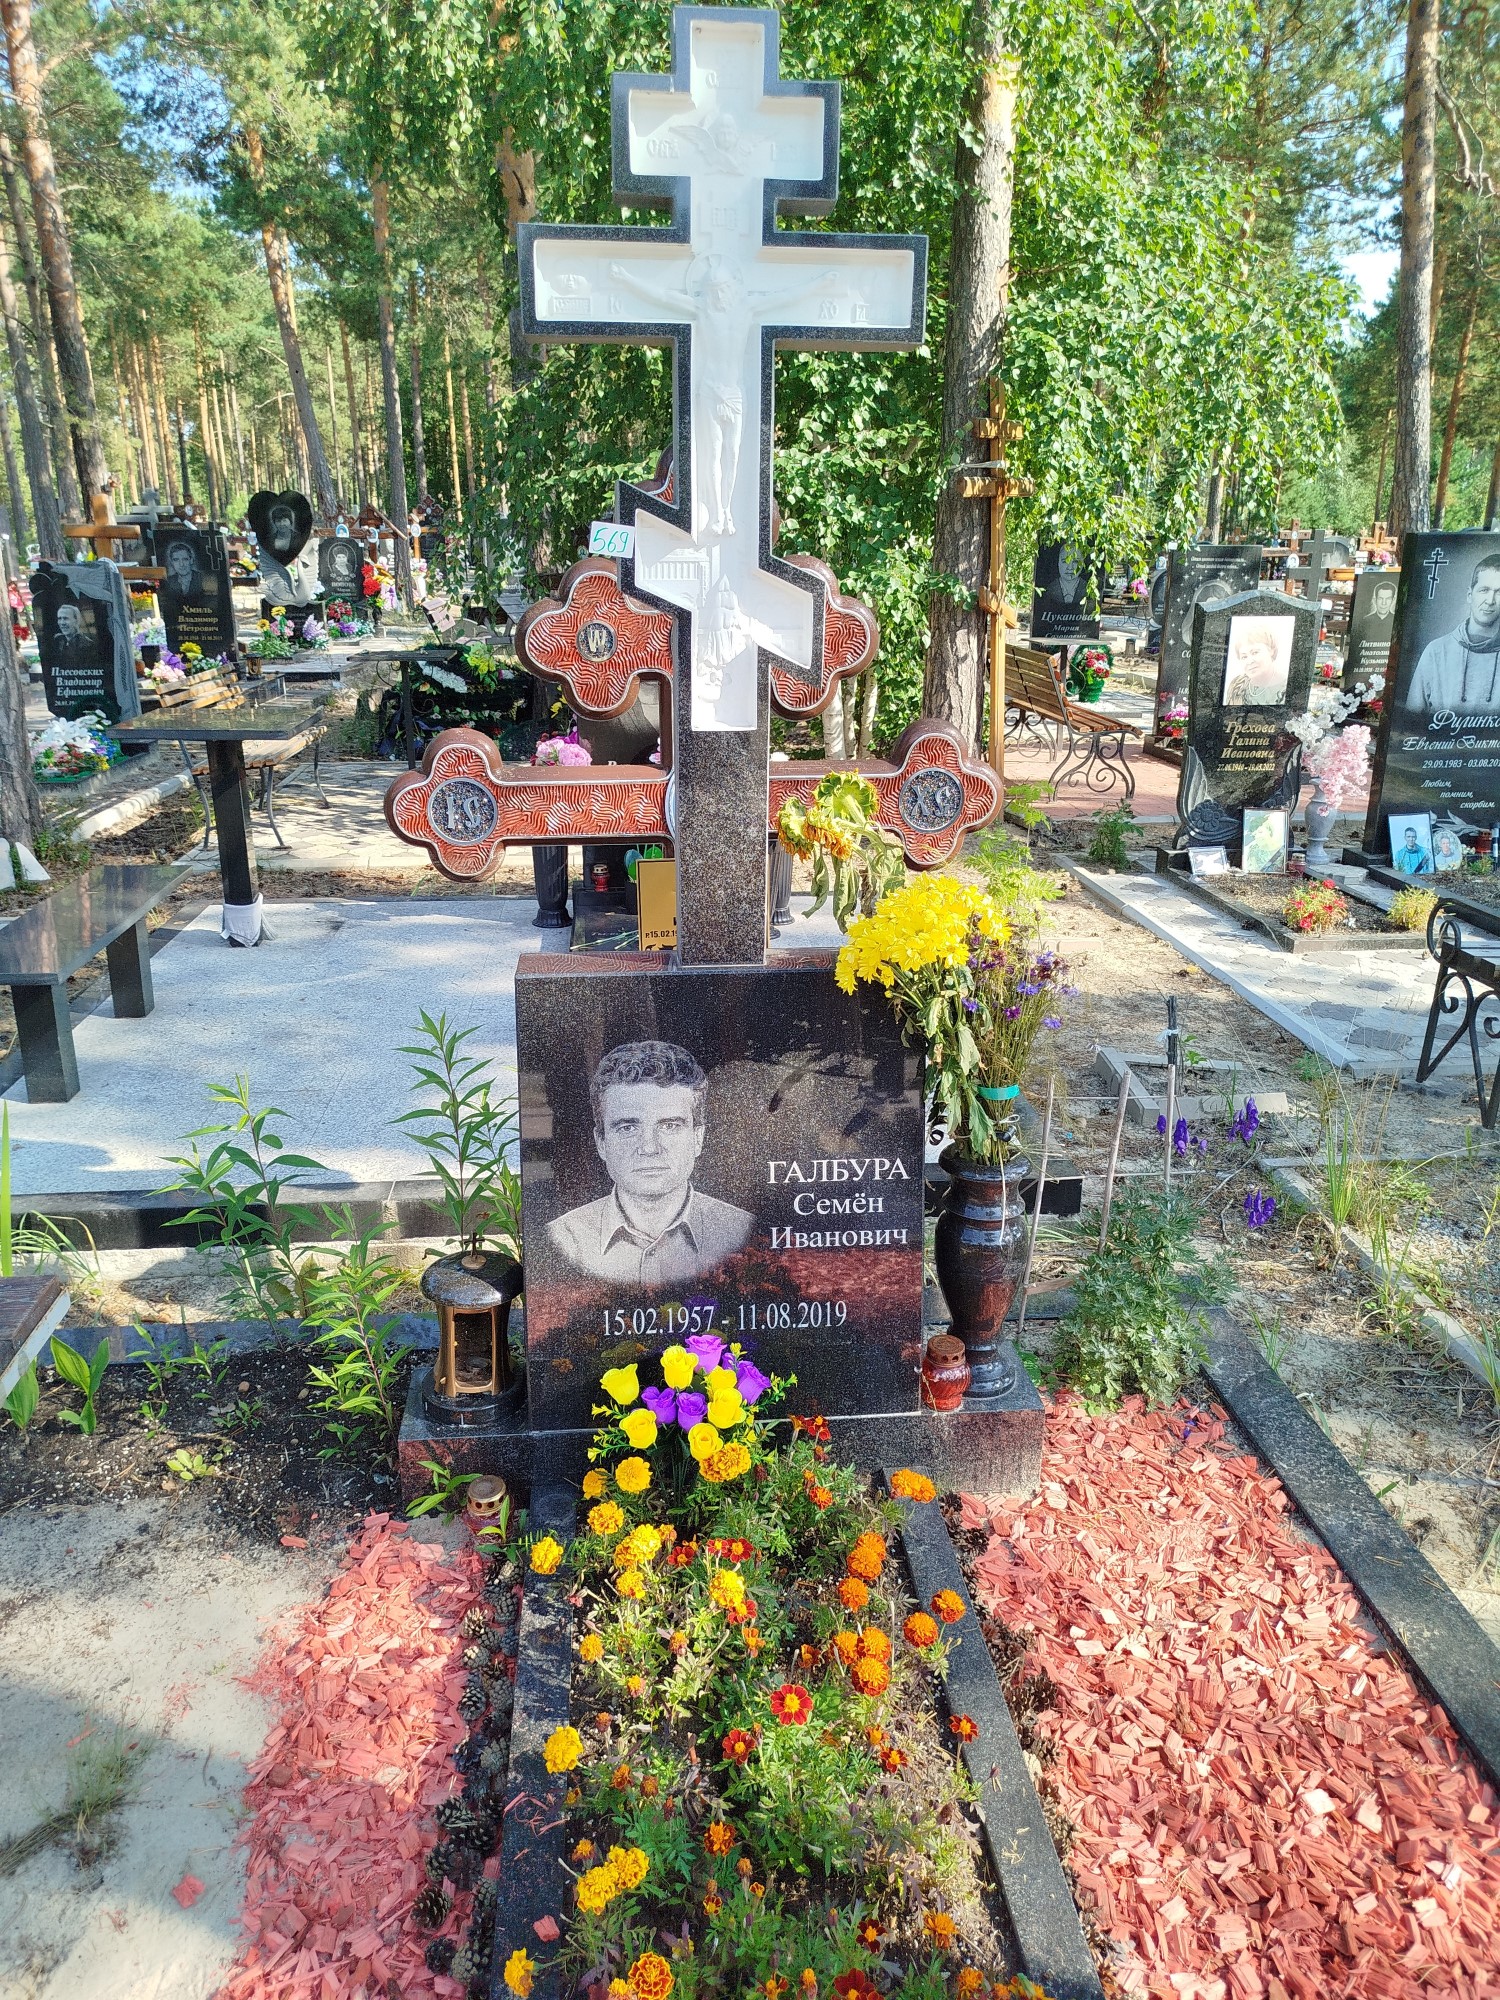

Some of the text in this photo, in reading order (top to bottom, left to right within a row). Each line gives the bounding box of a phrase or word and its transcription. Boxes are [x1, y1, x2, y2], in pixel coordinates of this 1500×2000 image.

[592, 527, 630, 553] 569
[183, 605, 213, 614] Хмиль
[178, 615, 219, 624] Владимир
[1041, 611, 1094, 623] Цуканова
[179, 624, 219, 633] Петрович
[1053, 624, 1080, 633] Мария
[51, 667, 105, 677] Плесовских
[56, 677, 103, 689] Владимир
[56, 686, 105, 698] Ефимович
[1225, 721, 1276, 735] Грехова
[1228, 733, 1271, 746] Галина
[1402, 736, 1456, 751] Евгений
[1220, 747, 1276, 759] Ивановна
[1422, 759, 1462, 769] 29.09.1983
[1420, 779, 1452, 788] Любим,
[1439, 791, 1474, 799] помним,
[767, 1157, 911, 1185] ГАЛБУРА
[792, 1192, 884, 1217] Семён
[769, 1226, 908, 1250] Иванович
[602, 1305, 715, 1336] 15.02.1957
[738, 1301, 847, 1331] 11.08.2019
